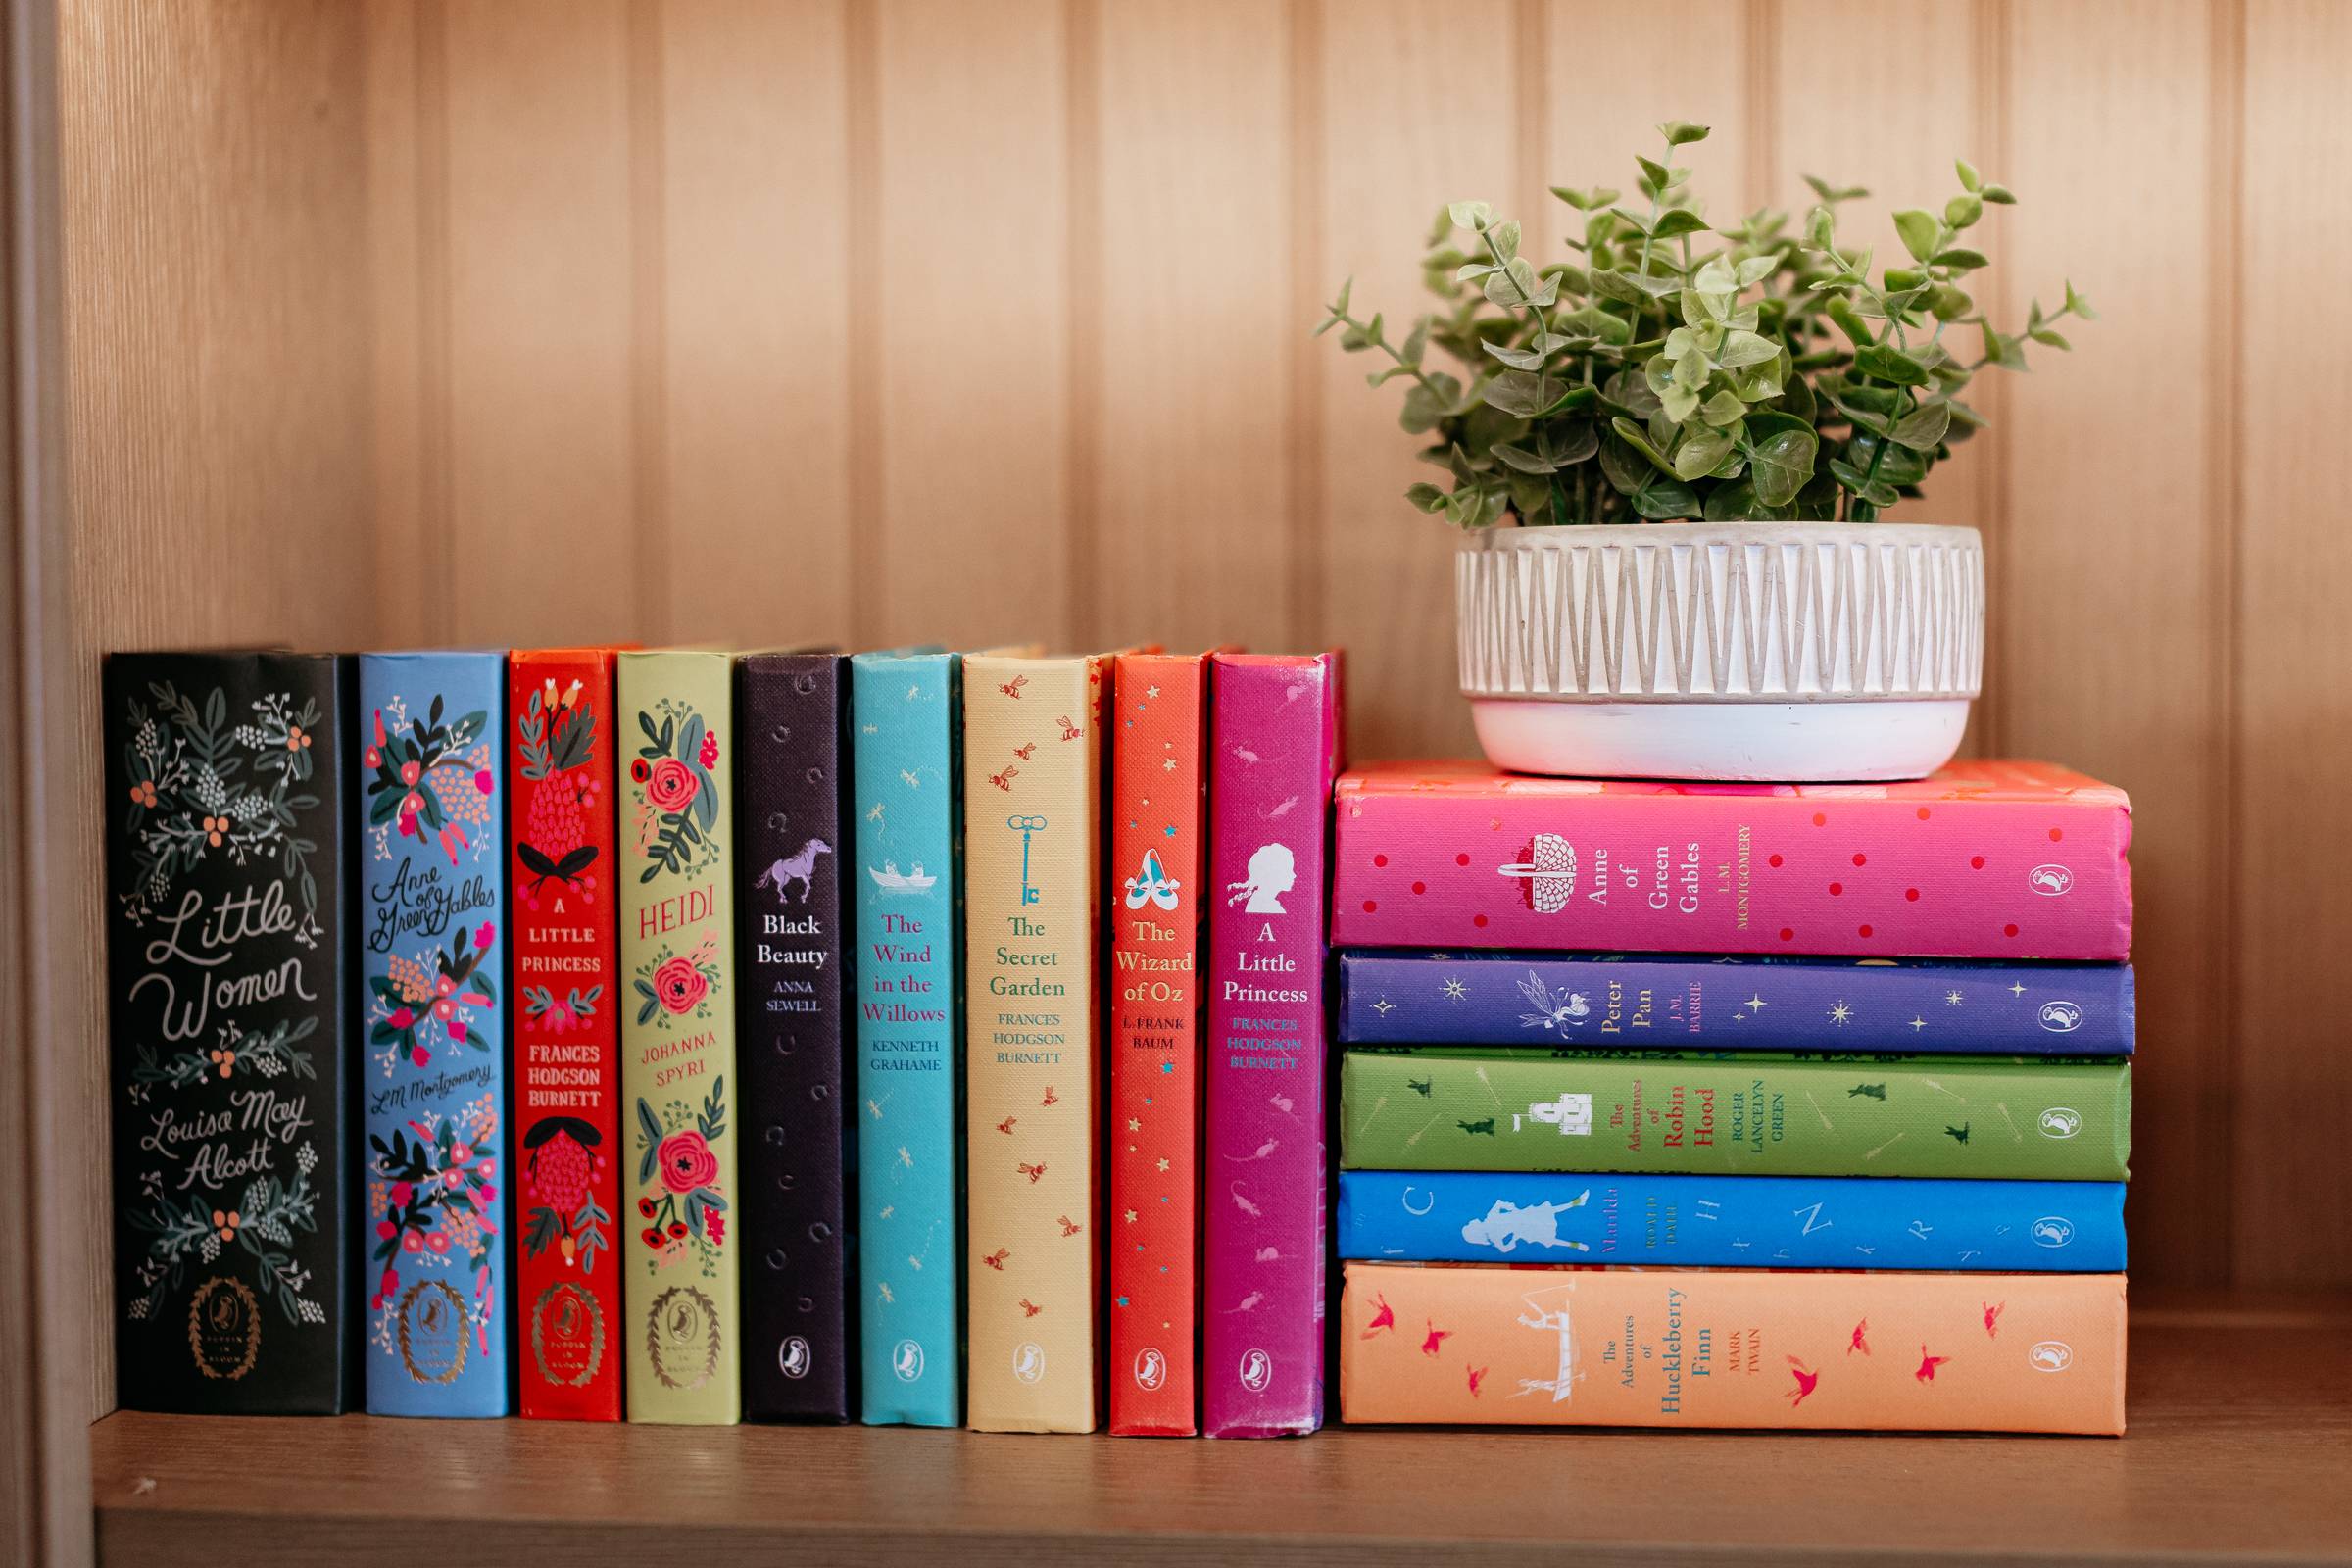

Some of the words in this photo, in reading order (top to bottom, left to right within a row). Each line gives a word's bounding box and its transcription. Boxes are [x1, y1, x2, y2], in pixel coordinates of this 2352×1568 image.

[372, 856, 443, 907] Anne
[1588, 848, 1608, 906] Anne
[1619, 863, 1639, 888] of
[1648, 846, 1669, 910] Green
[1679, 842, 1699, 913] Gables
[1737, 823, 1751, 931] MONTGOMERY
[416, 886, 435, 909] of
[553, 898, 565, 914] A
[147, 879, 296, 966] Little
[367, 902, 431, 954] Green
[416, 875, 495, 937] Gables
[639, 884, 714, 941] HEIDI
[762, 914, 821, 935] Black
[881, 914, 923, 934] The
[1008, 916, 1046, 936] The
[1132, 921, 1176, 942] The
[1257, 922, 1276, 943] A
[529, 928, 596, 943] LITTLE
[522, 956, 601, 972] PRINCESS
[757, 945, 828, 970] Beauty
[872, 944, 931, 963] Wind
[996, 947, 1058, 966] Secret
[1116, 951, 1193, 972] Wizard
[1238, 952, 1297, 972] Little
[773, 981, 814, 994] ANNA
[874, 976, 893, 993] in
[900, 975, 932, 993] the
[989, 976, 1065, 997] Garden
[1124, 981, 1149, 1002] of
[1151, 982, 1184, 1003] Oz
[1224, 981, 1308, 1003] Princess
[128, 957, 318, 1041] Women
[766, 1000, 821, 1012] SEWELL
[1601, 979, 1622, 1034] Peter
[1632, 988, 1652, 1028] Pan
[1690, 980, 1701, 1033] BARRIE
[863, 1003, 946, 1022] Willows
[998, 1014, 1060, 1026] FRANCES
[1137, 1017, 1185, 1030] FRANK
[1233, 1017, 1298, 1031] FRANCES
[641, 1031, 716, 1065] JOHANNA
[872, 1040, 939, 1052] KENNETH
[993, 1033, 1065, 1045] HODGSON
[1133, 1037, 1175, 1050] BAUM
[1227, 1037, 1302, 1051] HODGSON
[529, 1045, 600, 1063] FRANCES
[870, 1059, 941, 1071] GRAHAME
[997, 1052, 1062, 1064] BURNETT
[1230, 1056, 1299, 1069] BURNETT
[410, 1065, 495, 1101] Montgomery
[527, 1068, 600, 1086] HODGSON
[656, 1060, 706, 1087] SPYRI
[527, 1090, 602, 1107] BURNETT
[141, 1108, 233, 1159] Louisa
[230, 1090, 314, 1144] May
[1610, 1104, 1624, 1128] The
[1626, 1079, 1642, 1152] Adventures
[1646, 1108, 1659, 1125] of
[1663, 1085, 1686, 1148] Robin
[1693, 1088, 1714, 1147] Hood
[1731, 1092, 1744, 1143] ROGER
[1751, 1080, 1764, 1153] LANCELYN
[1772, 1093, 1784, 1142] GREEN
[177, 1137, 274, 1190] Alcott
[1602, 1340, 1616, 1364] The
[1621, 1315, 1634, 1388] Adventures
[1640, 1344, 1652, 1360] of
[1662, 1287, 1687, 1414] Huckleberry
[1691, 1328, 1711, 1377] Finn
[1729, 1330, 1741, 1372] MARK
[1748, 1328, 1761, 1375] TWAIN
